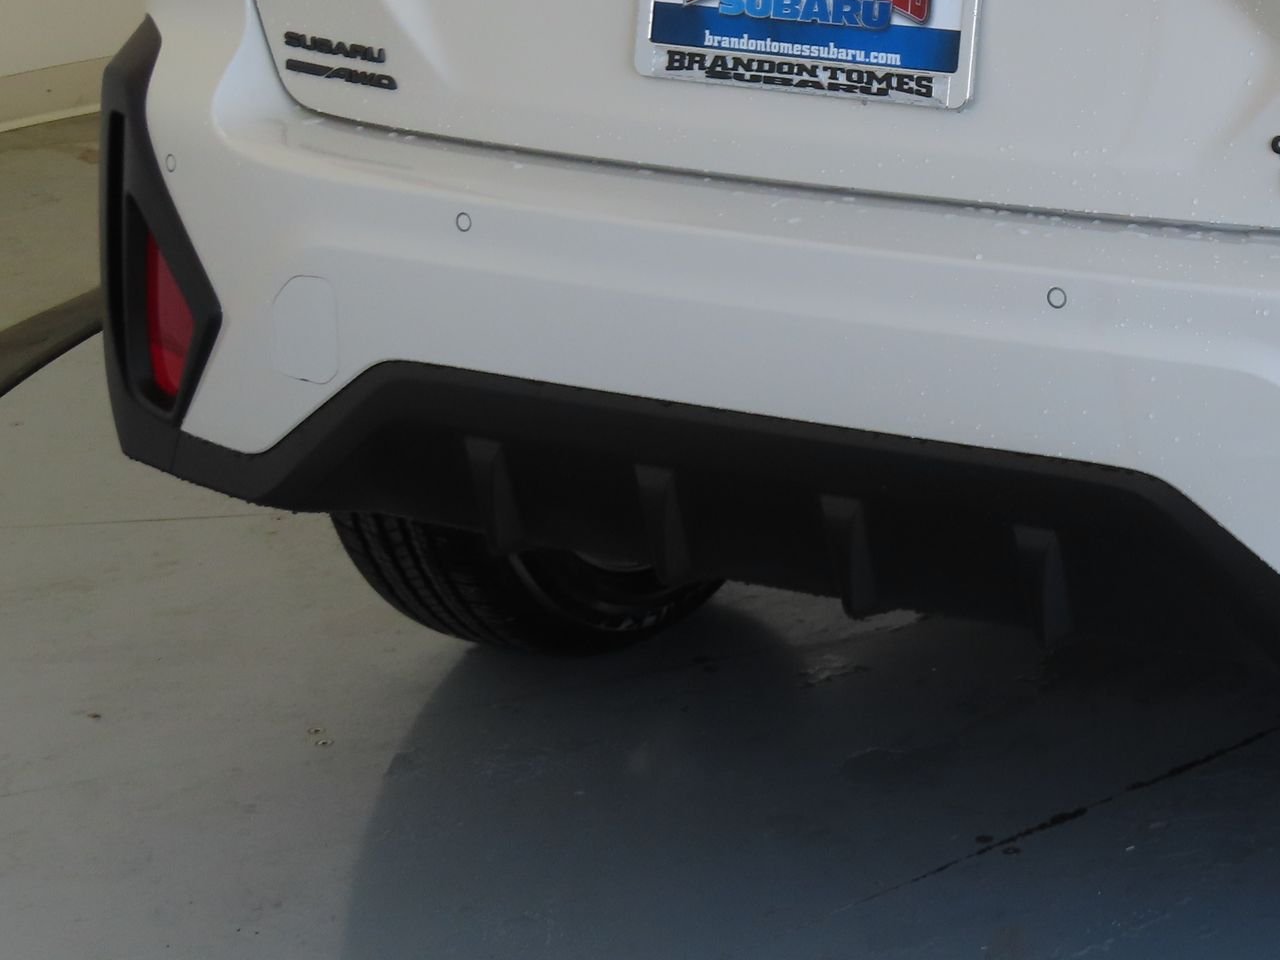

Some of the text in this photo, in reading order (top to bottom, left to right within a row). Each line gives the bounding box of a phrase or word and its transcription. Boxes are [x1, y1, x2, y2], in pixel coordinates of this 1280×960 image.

[284, 31, 386, 63] SUBARU
[704, 30, 901, 66] brandontomessubaru.com
[665, 50, 934, 98] BRANDON TOMES
[705, 69, 890, 96] SUBARU
